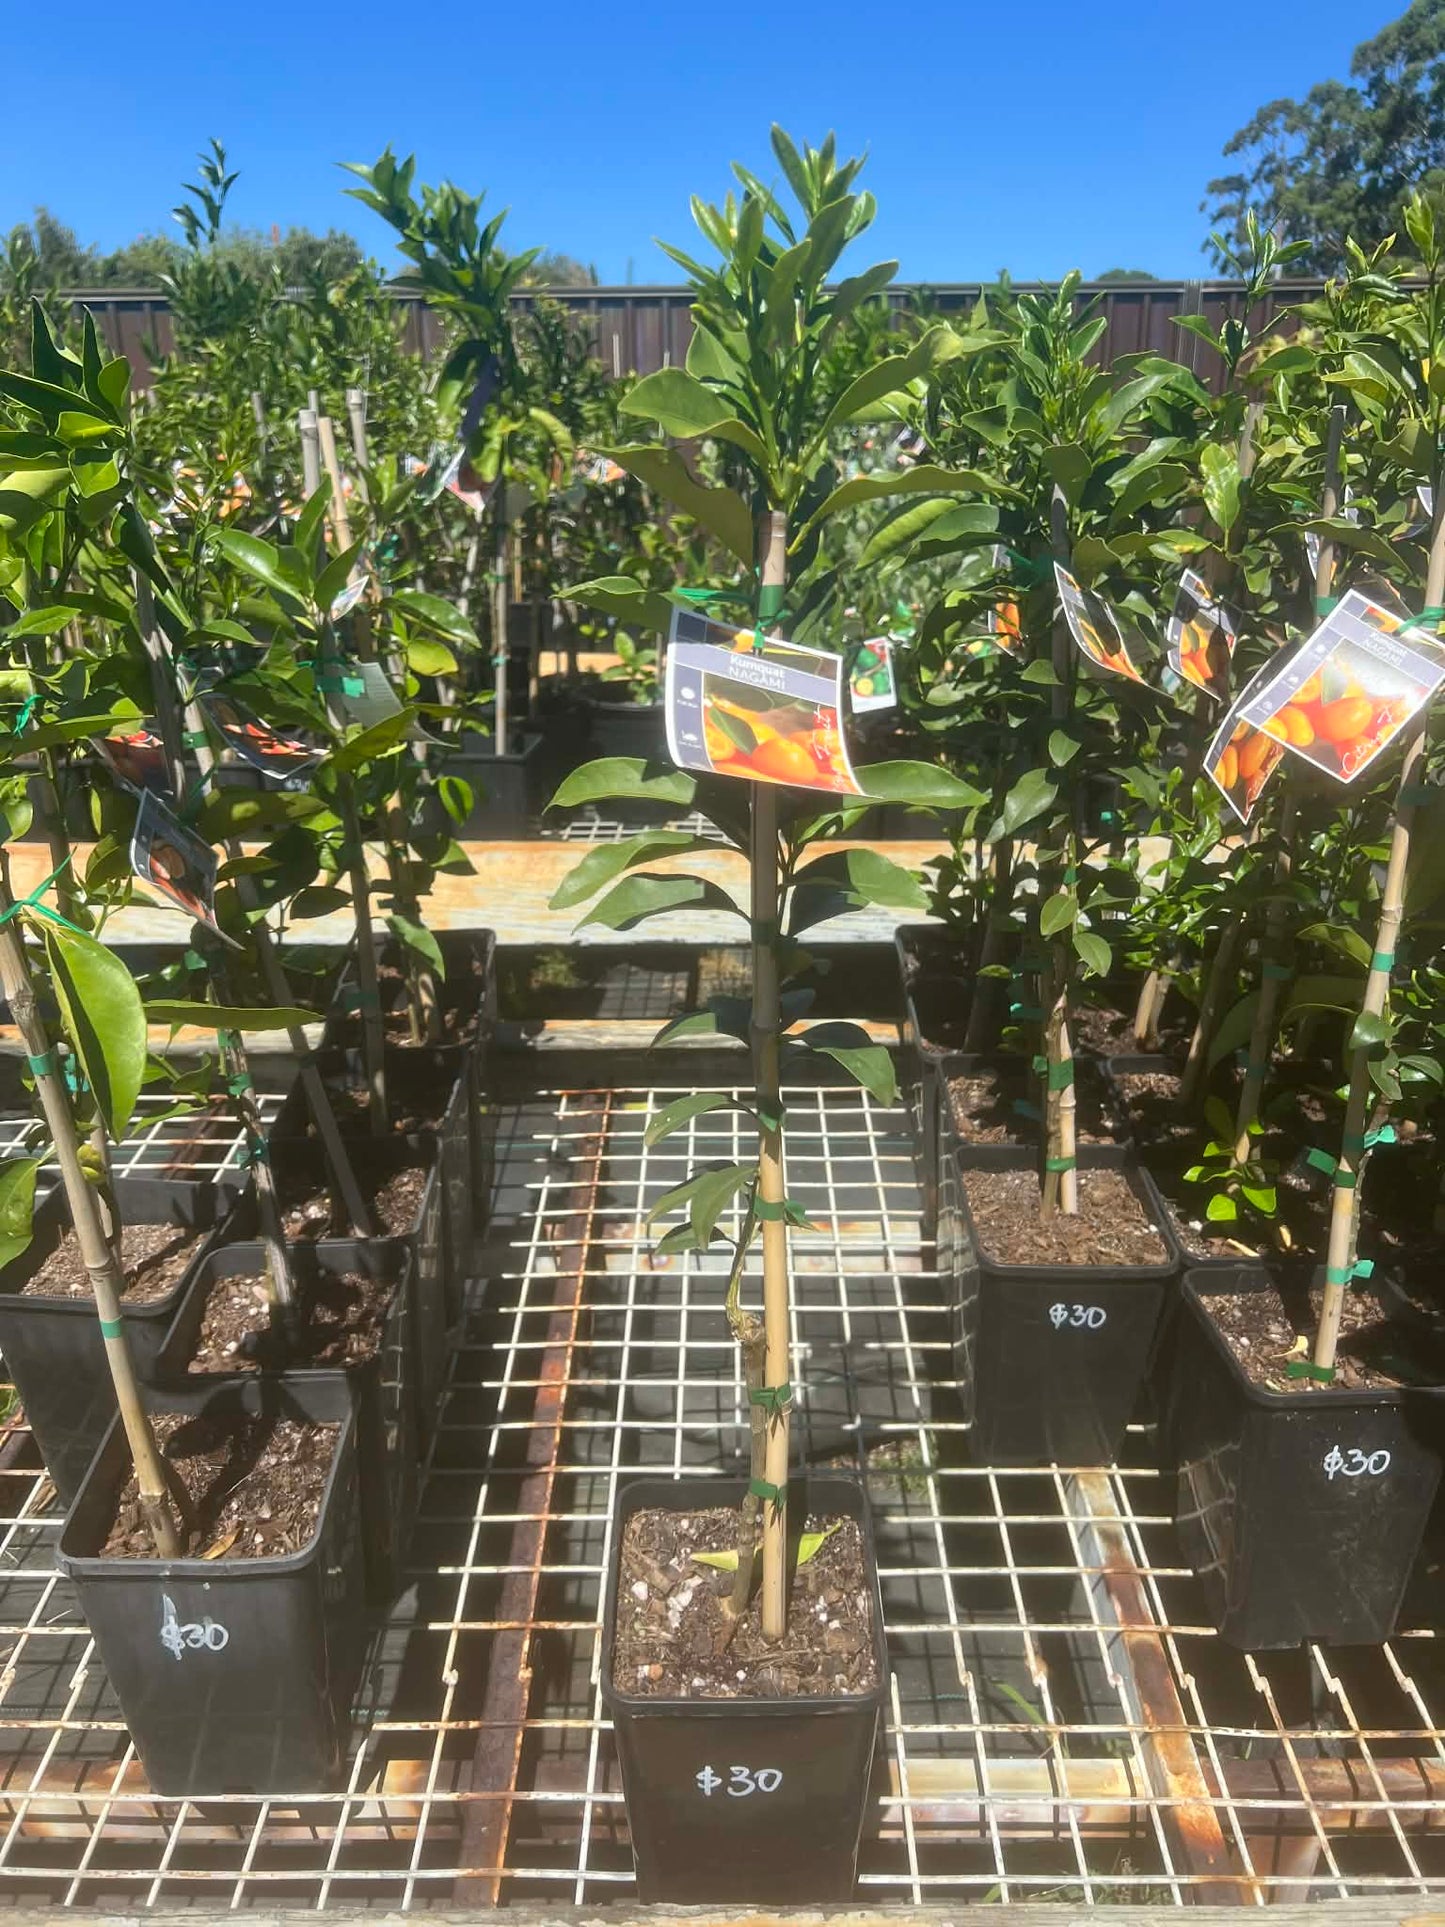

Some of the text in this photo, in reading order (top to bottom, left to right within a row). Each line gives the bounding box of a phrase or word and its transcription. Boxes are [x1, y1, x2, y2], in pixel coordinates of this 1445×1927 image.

[729, 666, 786, 690] NAGAMI
[730, 654, 786, 679] Kumquat
[1048, 1303, 1107, 1329] $30
[1323, 1444, 1391, 1480] $30
[161, 1612, 229, 1661] $30
[695, 1765, 783, 1797] $30
